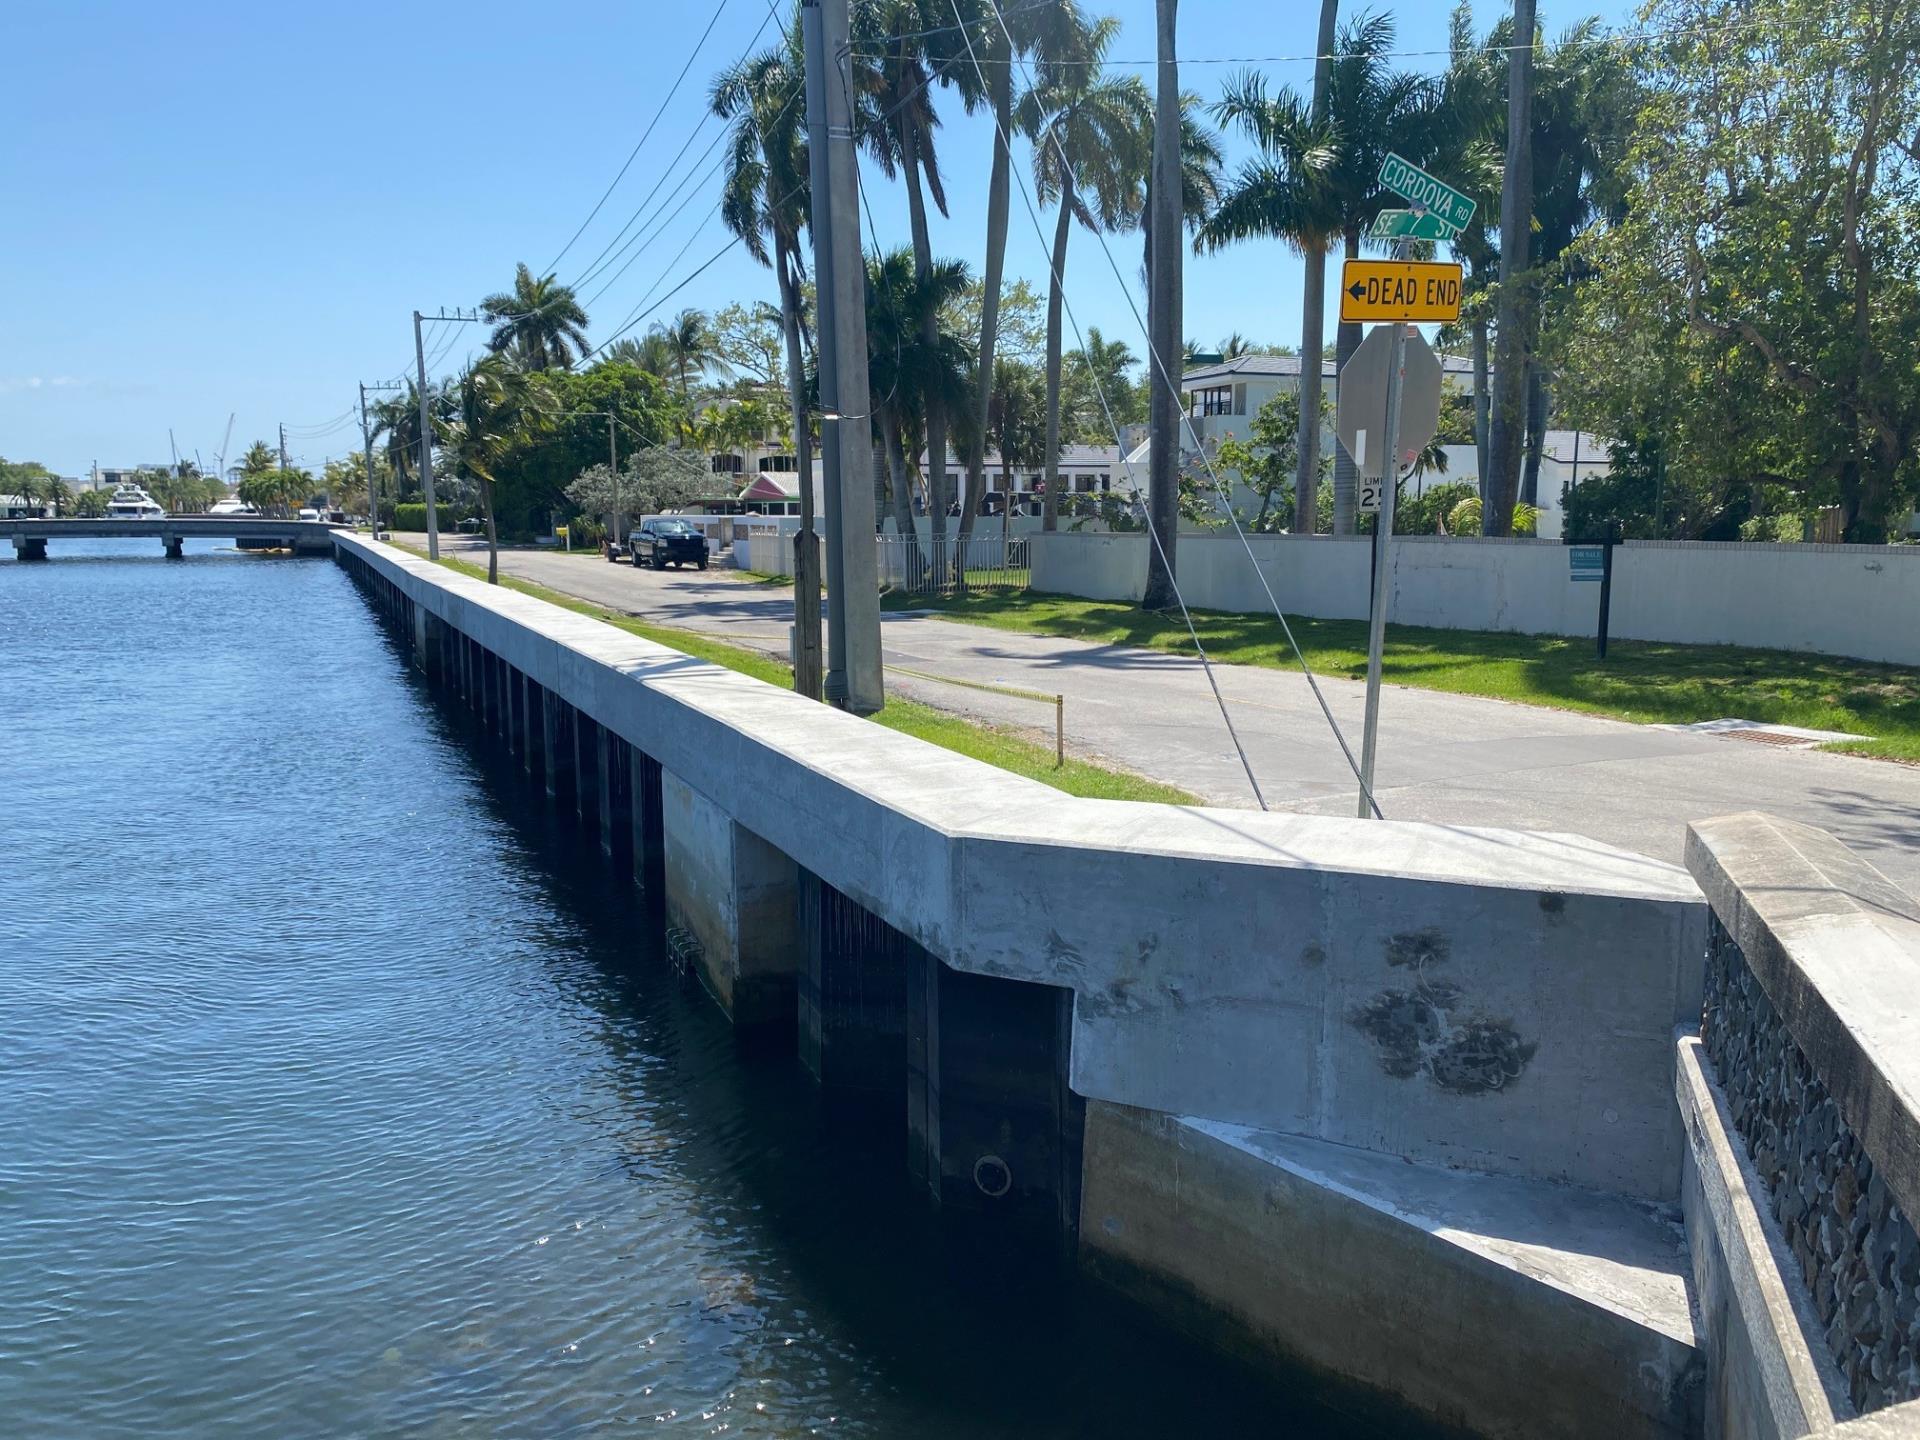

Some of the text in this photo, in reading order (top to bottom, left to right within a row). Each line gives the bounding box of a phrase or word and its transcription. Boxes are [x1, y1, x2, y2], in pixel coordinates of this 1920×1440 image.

[1383, 160, 1469, 221] CORDOVA RD
[1375, 214, 1398, 235] SE
[1367, 277, 1458, 305] DEAD END
